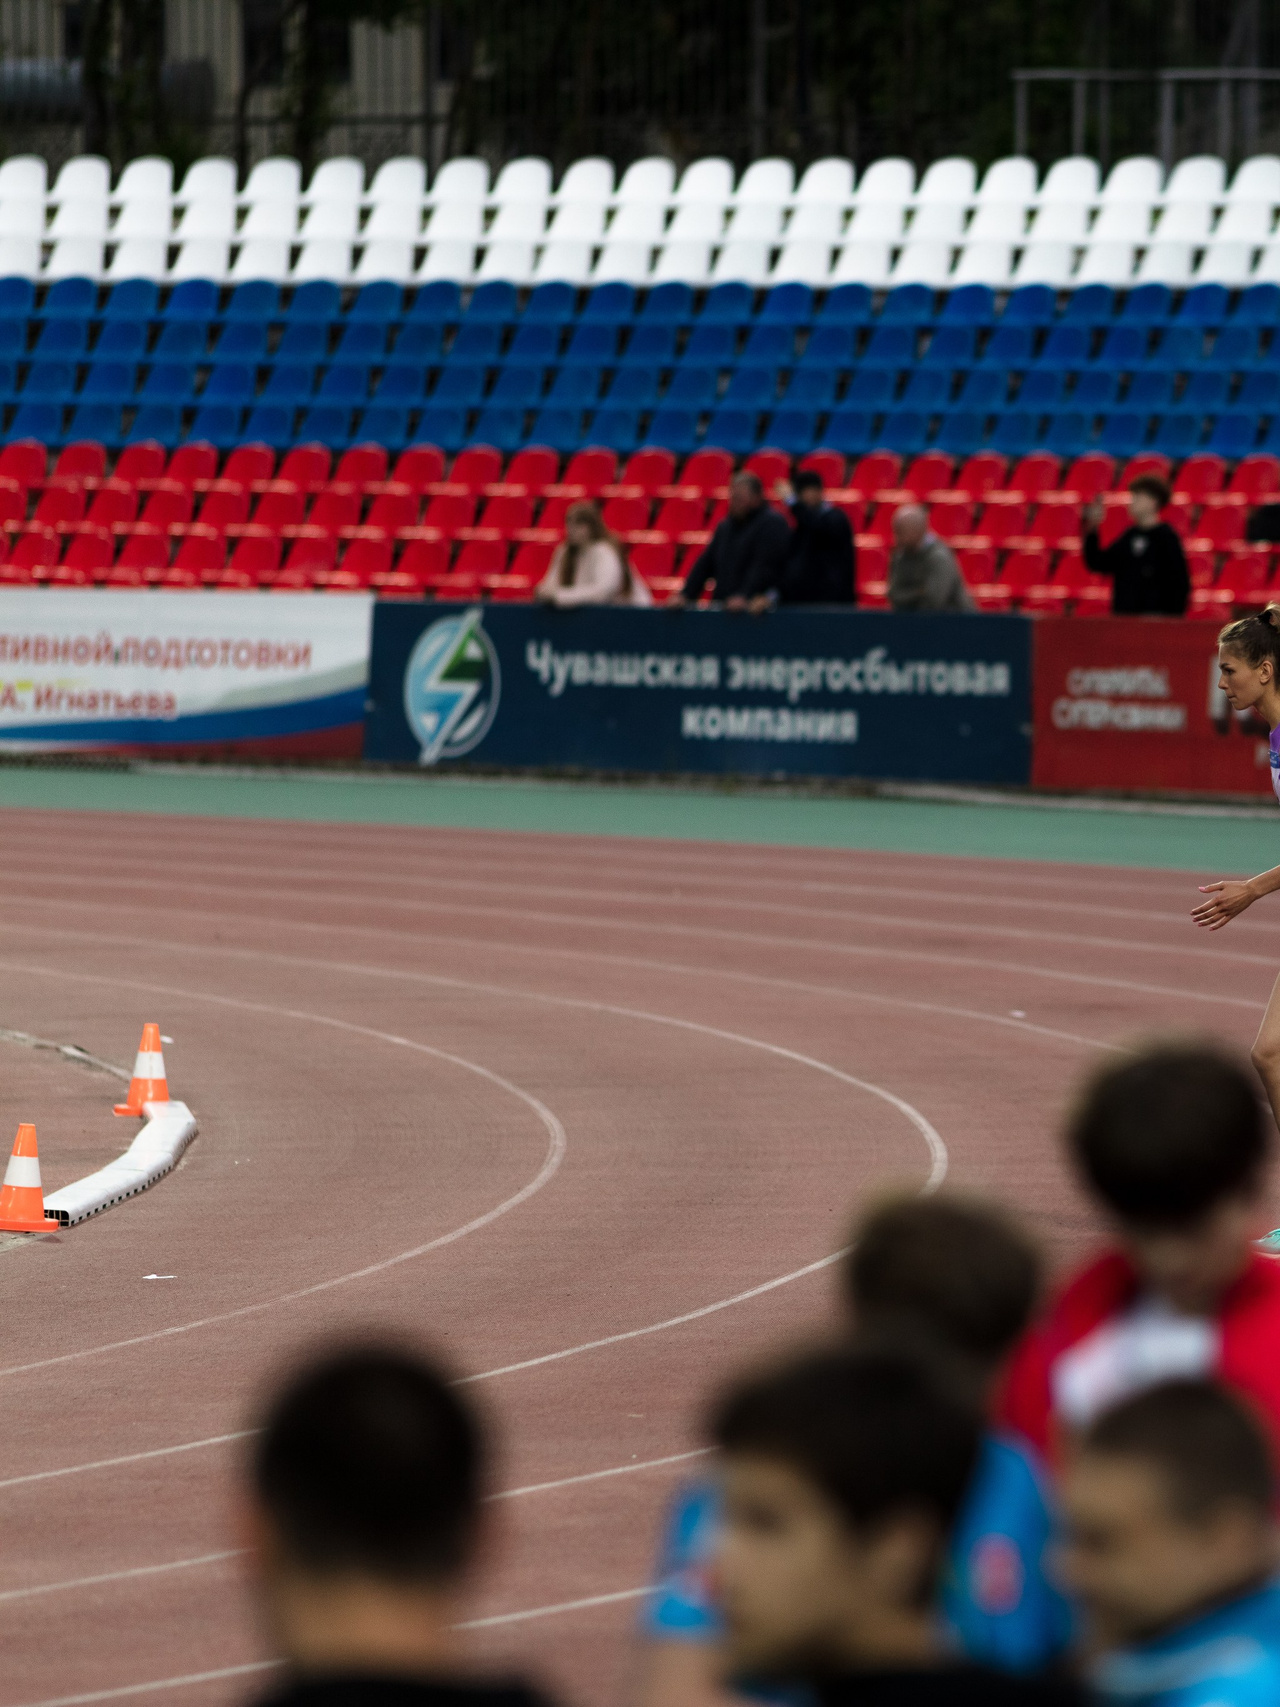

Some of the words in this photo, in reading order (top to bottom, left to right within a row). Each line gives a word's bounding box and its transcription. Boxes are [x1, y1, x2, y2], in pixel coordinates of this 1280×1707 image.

[526, 639, 721, 697] Чувашская
[727, 646, 1011, 703] энергосбытовая
[681, 705, 858, 743] компания
